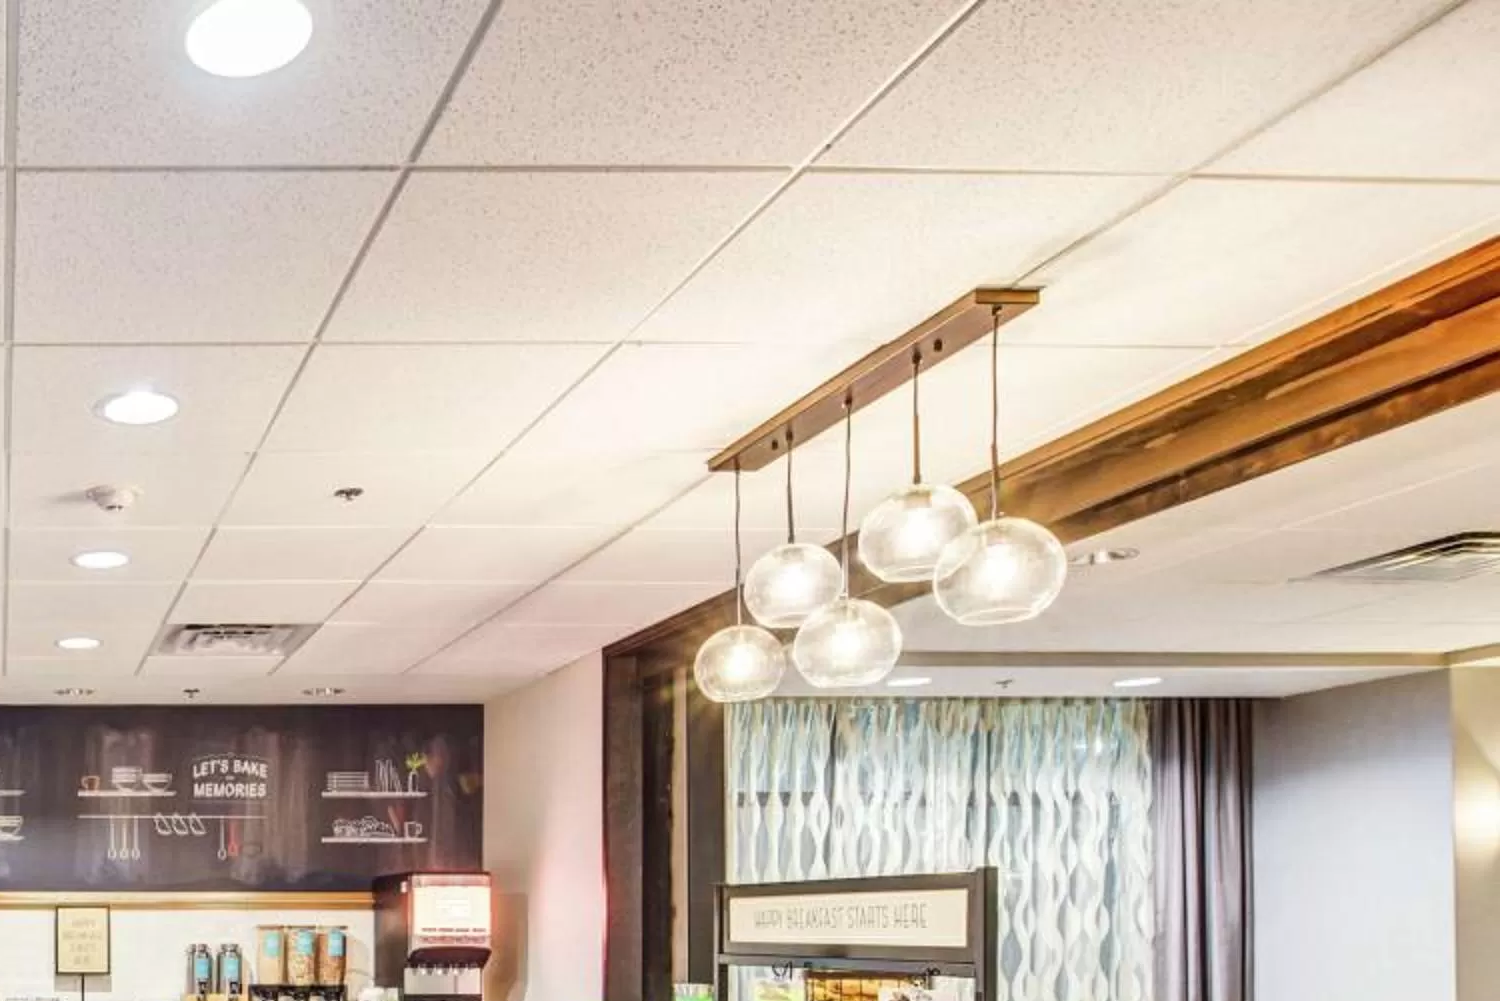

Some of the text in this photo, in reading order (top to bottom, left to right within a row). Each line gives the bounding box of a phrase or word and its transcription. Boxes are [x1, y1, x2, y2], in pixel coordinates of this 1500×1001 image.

[193, 759, 269, 779] LET'S BAKE
[193, 782, 267, 798] MEMORIES
[787, 905, 843, 930] BREAKFAST
[847, 903, 889, 929] STARTS
[894, 902, 929, 929] HERE
